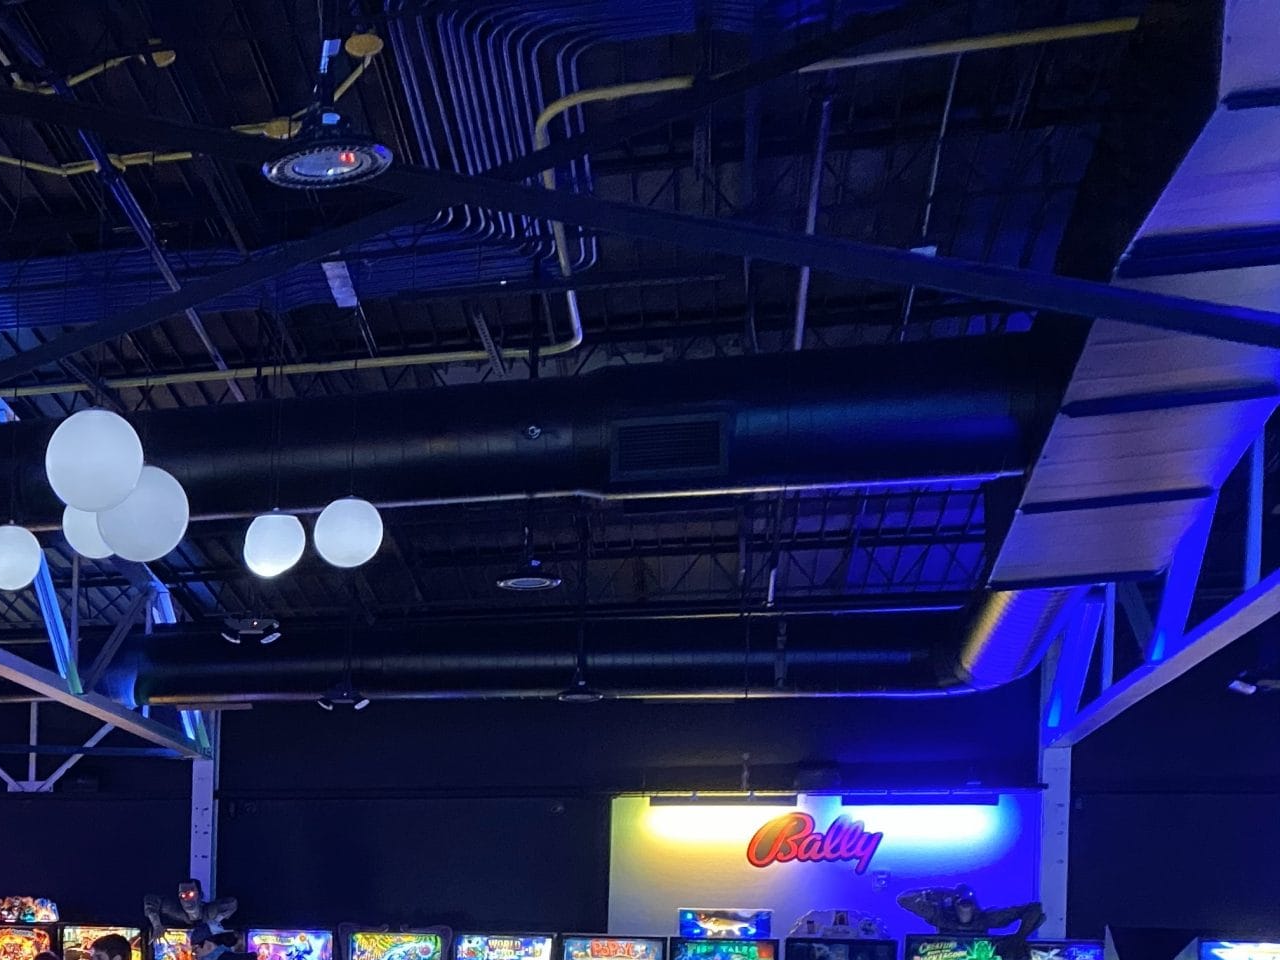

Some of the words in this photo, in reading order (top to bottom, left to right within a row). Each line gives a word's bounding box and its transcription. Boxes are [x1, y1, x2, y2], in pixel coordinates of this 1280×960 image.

[747, 812, 884, 875] Bally
[488, 939, 522, 949] WORLD
[722, 944, 758, 957] TALES
